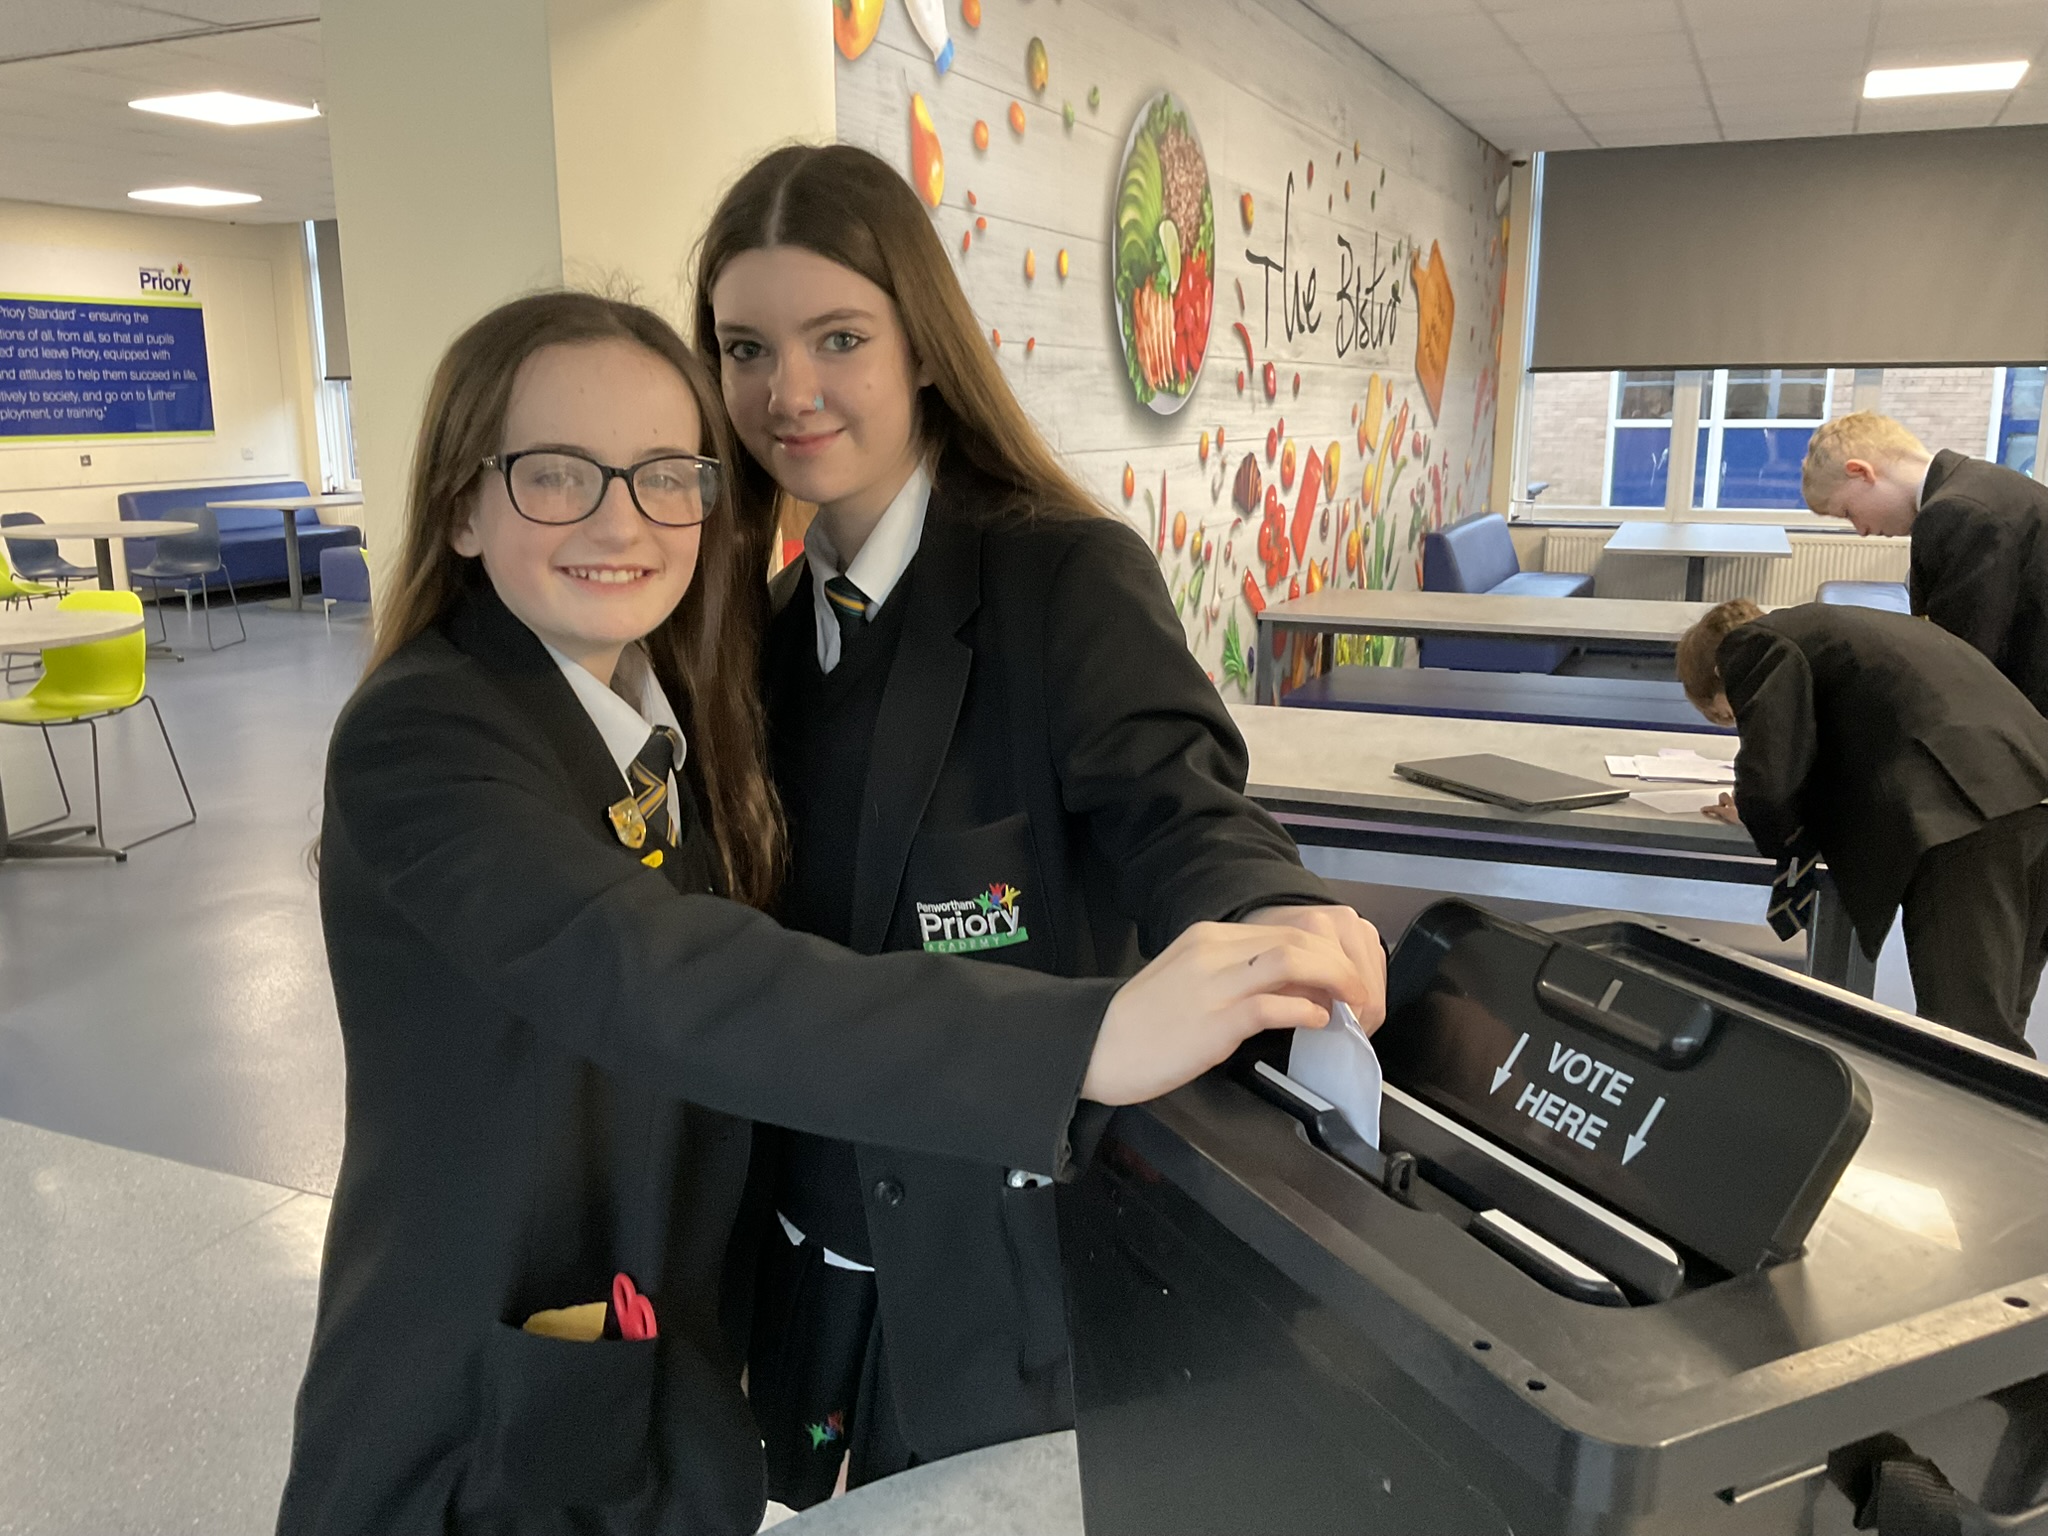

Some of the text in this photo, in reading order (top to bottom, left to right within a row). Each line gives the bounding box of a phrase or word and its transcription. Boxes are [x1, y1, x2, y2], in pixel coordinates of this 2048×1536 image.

[1245, 171, 1321, 348] The
[1336, 231, 1401, 358] Bistro
[140, 271, 191, 296] Priory
[89, 311, 131, 325] ensuring
[134, 311, 149, 324] the
[28, 328, 38, 341] of
[57, 329, 80, 342] from
[98, 332, 110, 344] so
[113, 331, 131, 344] that
[133, 332, 144, 344] all
[147, 333, 175, 346] pupils
[18, 346, 38, 359] and
[41, 346, 69, 360] leave
[103, 348, 150, 362] equipped
[152, 349, 171, 361] with
[0, 368, 16, 381] nd
[19, 368, 63, 381] attitudes
[65, 368, 76, 381] to
[78, 368, 100, 383] help
[102, 369, 128, 381] them
[130, 369, 171, 381] succeed
[173, 368, 181, 381] in
[0, 389, 27, 405] tively
[29, 390, 41, 403] to
[83, 389, 102, 402] and
[104, 391, 119, 405] go
[120, 391, 134, 402] on
[136, 389, 146, 402] to
[147, 389, 176, 402] further
[53, 408, 64, 419] or
[916, 899, 976, 913] Penwortham
[919, 905, 1020, 942] Priory
[928, 936, 1000, 953] ACADEMY
[1548, 1041, 1635, 1106] VOTE
[1515, 1082, 1609, 1150] HERE
